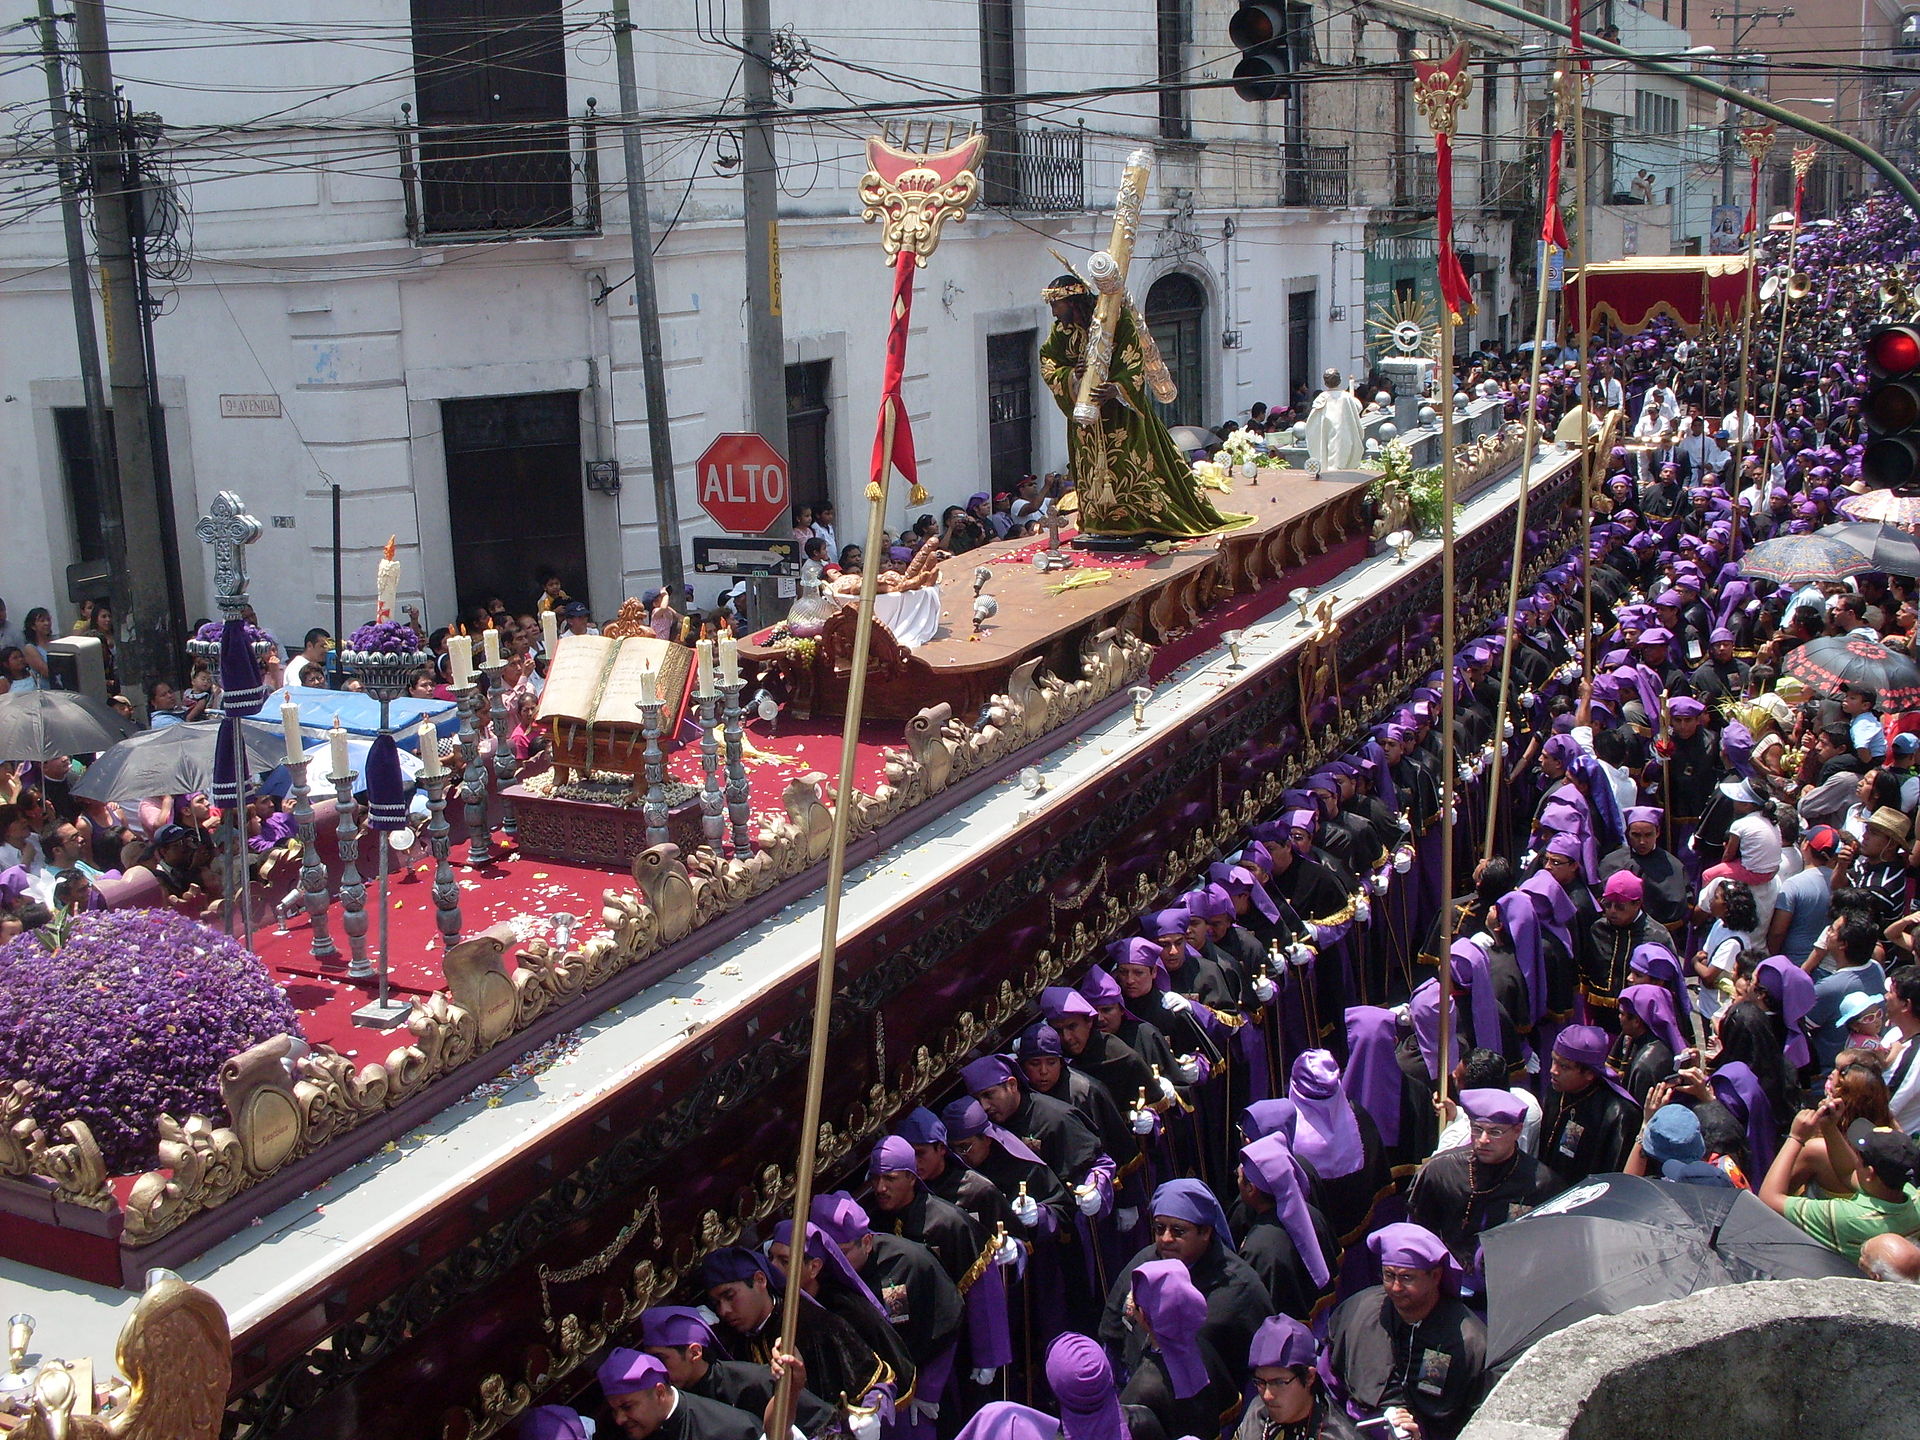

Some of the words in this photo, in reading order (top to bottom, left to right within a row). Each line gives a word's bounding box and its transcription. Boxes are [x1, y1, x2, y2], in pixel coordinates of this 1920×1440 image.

[1374, 238, 1395, 261] FOTO
[239, 399, 276, 412] AVENIDA
[703, 463, 784, 504] ALTO
